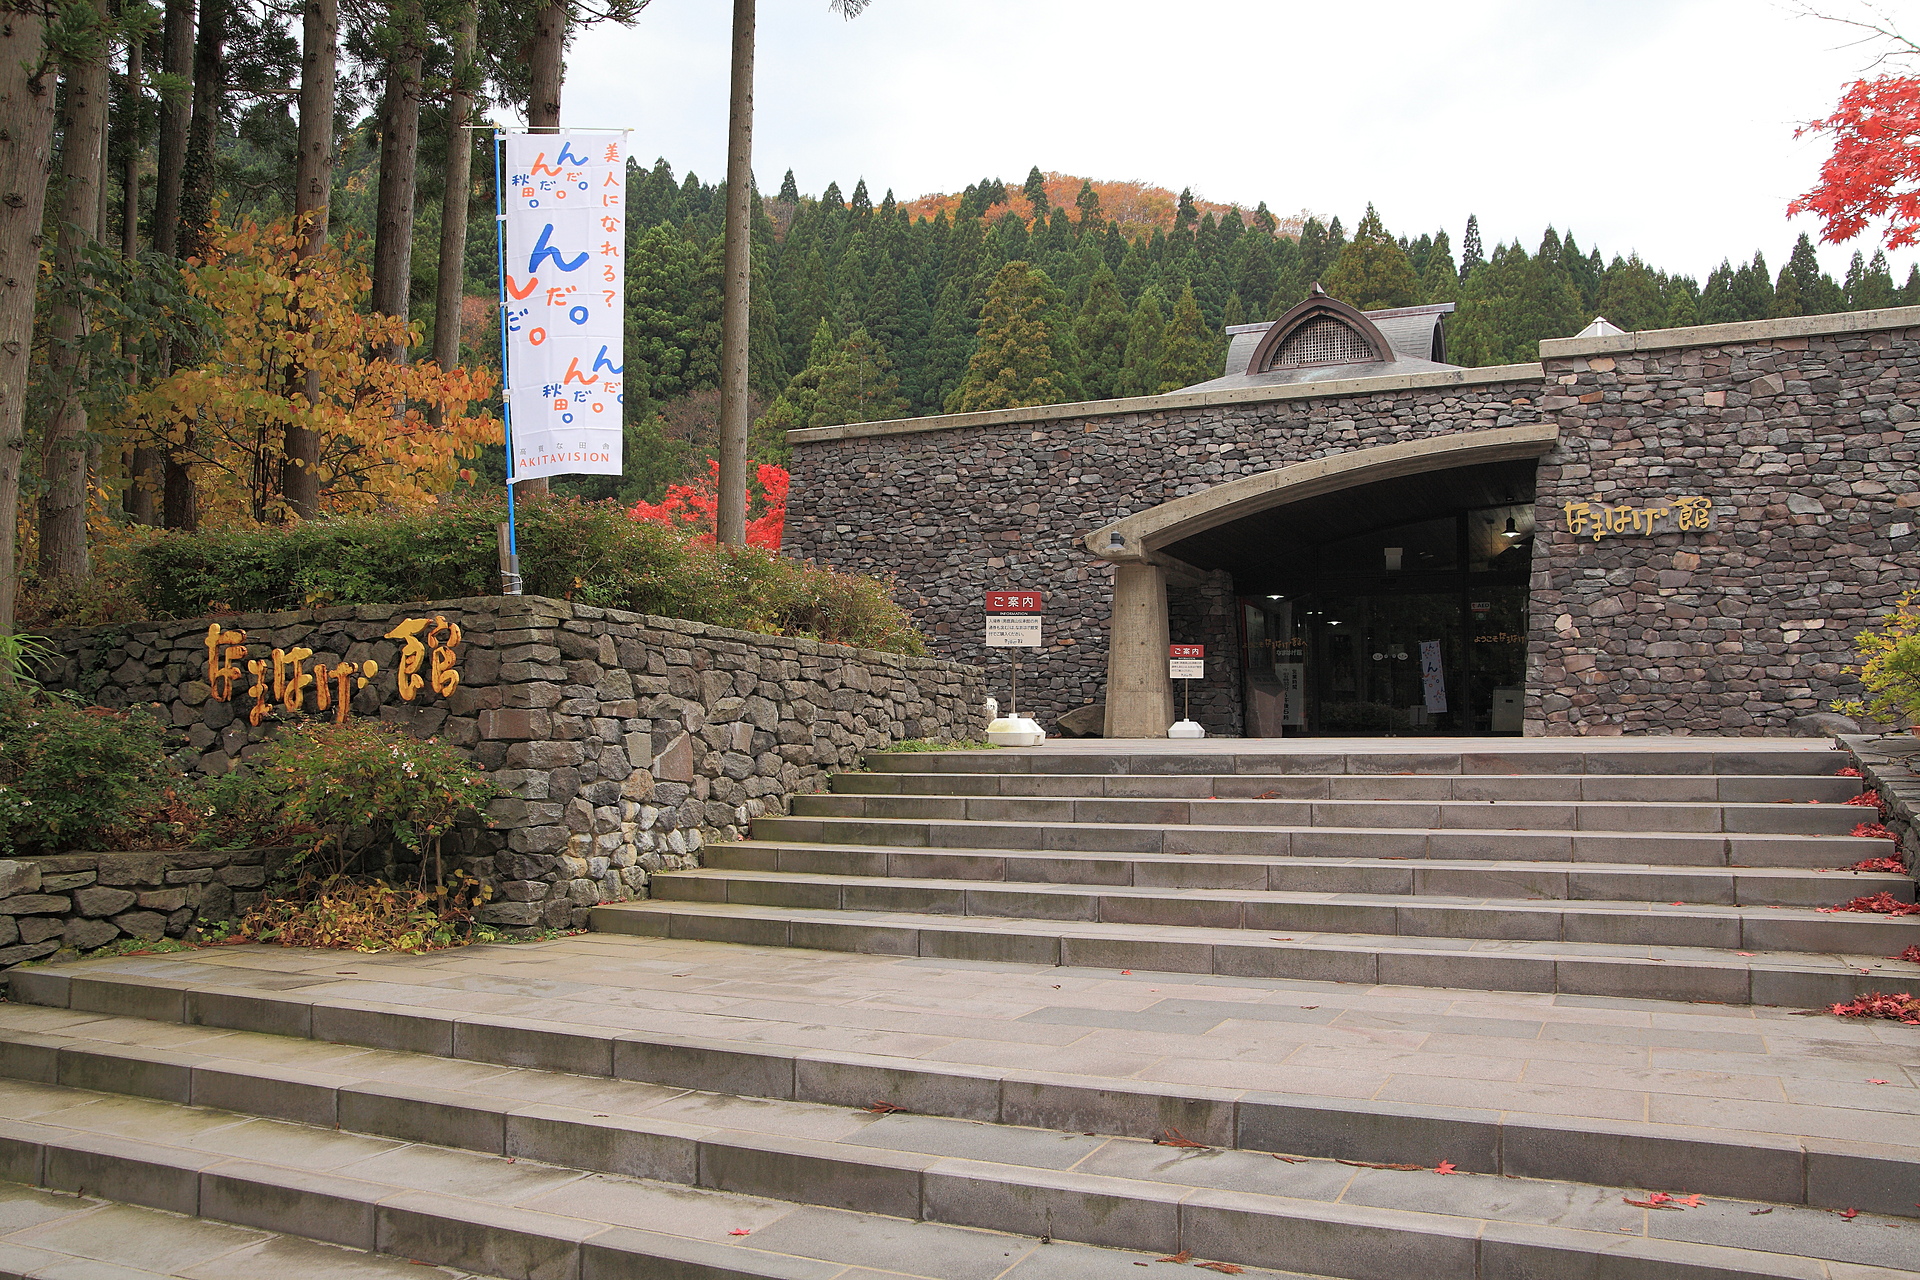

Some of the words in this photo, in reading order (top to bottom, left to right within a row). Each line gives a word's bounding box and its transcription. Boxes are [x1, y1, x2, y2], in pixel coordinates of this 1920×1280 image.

[519, 452, 609, 468] AKITAVISION
[1563, 496, 1712, 541] なまはげ館
[993, 596, 1034, 608] ご案内
[1174, 647, 1199, 655] ご案内
[204, 615, 462, 727] なまはげ館
